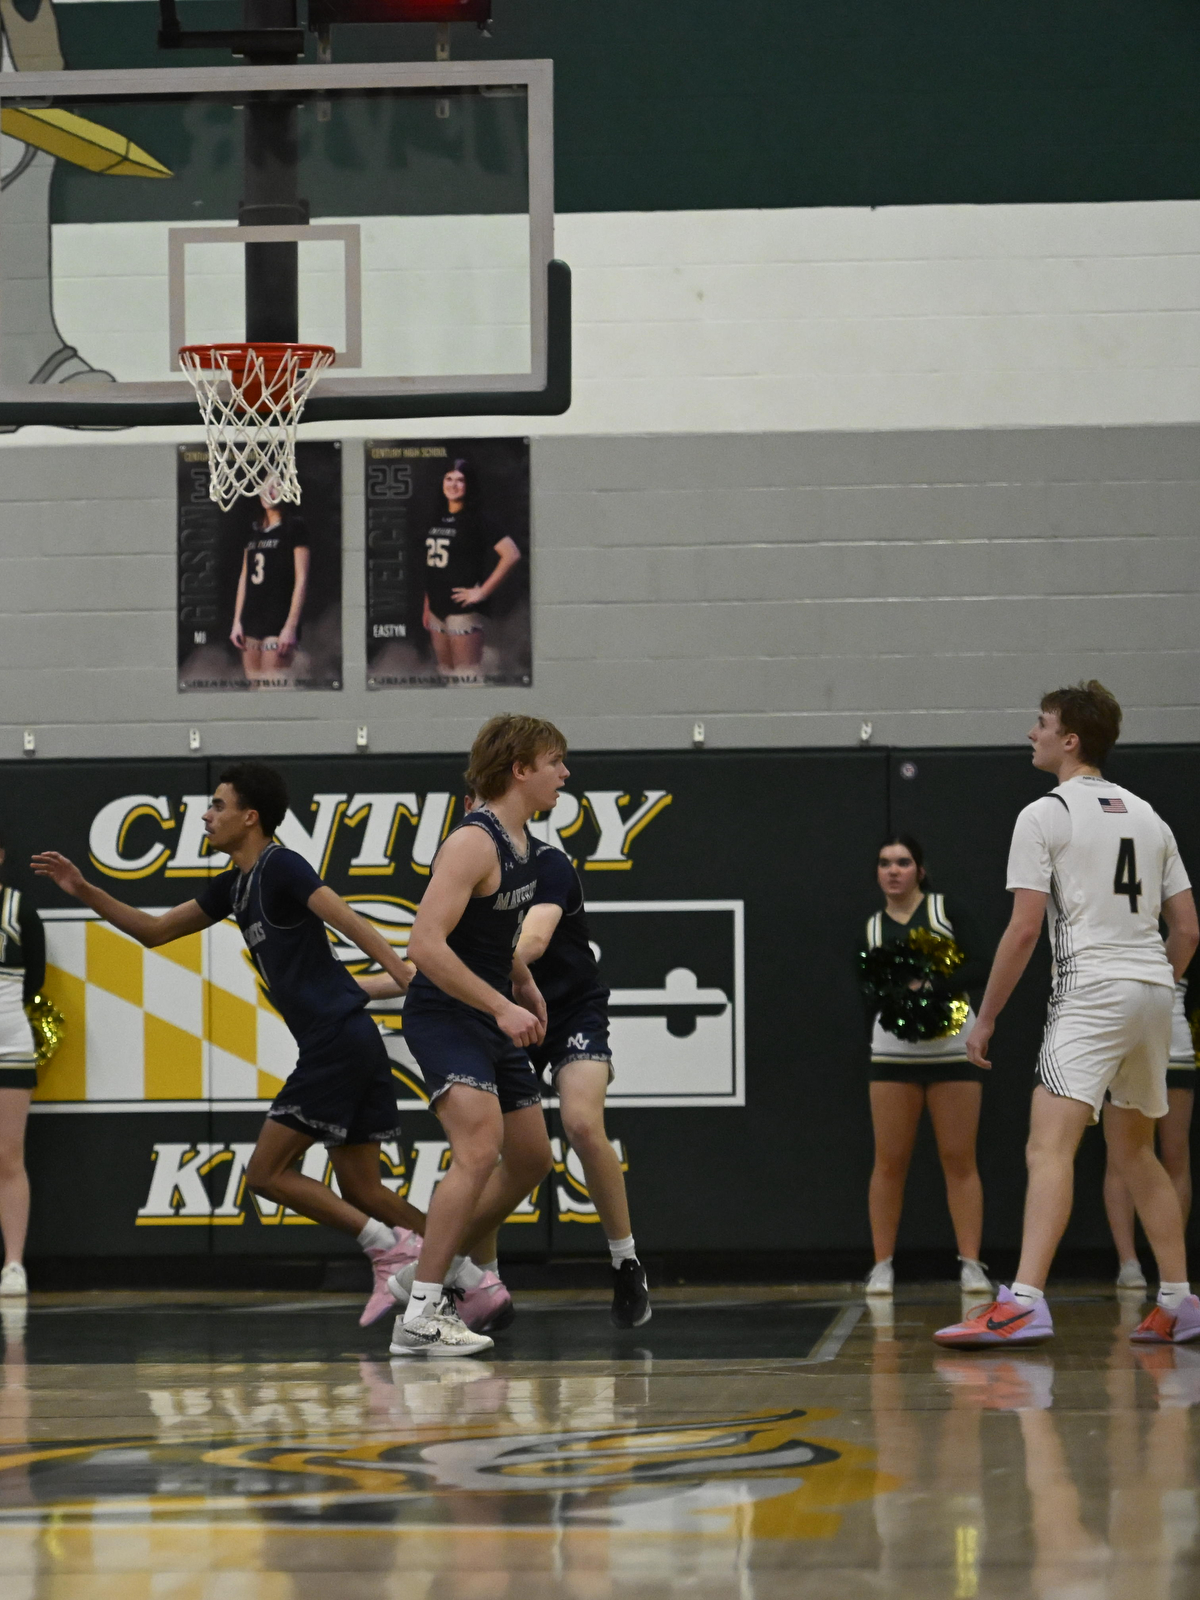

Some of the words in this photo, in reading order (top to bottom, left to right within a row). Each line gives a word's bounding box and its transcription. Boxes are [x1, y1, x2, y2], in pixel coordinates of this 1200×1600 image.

[367, 464, 413, 500] 25
[251, 552, 265, 585] 3
[425, 538, 450, 569] 25
[373, 624, 407, 638] EASTYN
[1113, 836, 1143, 914] 4
